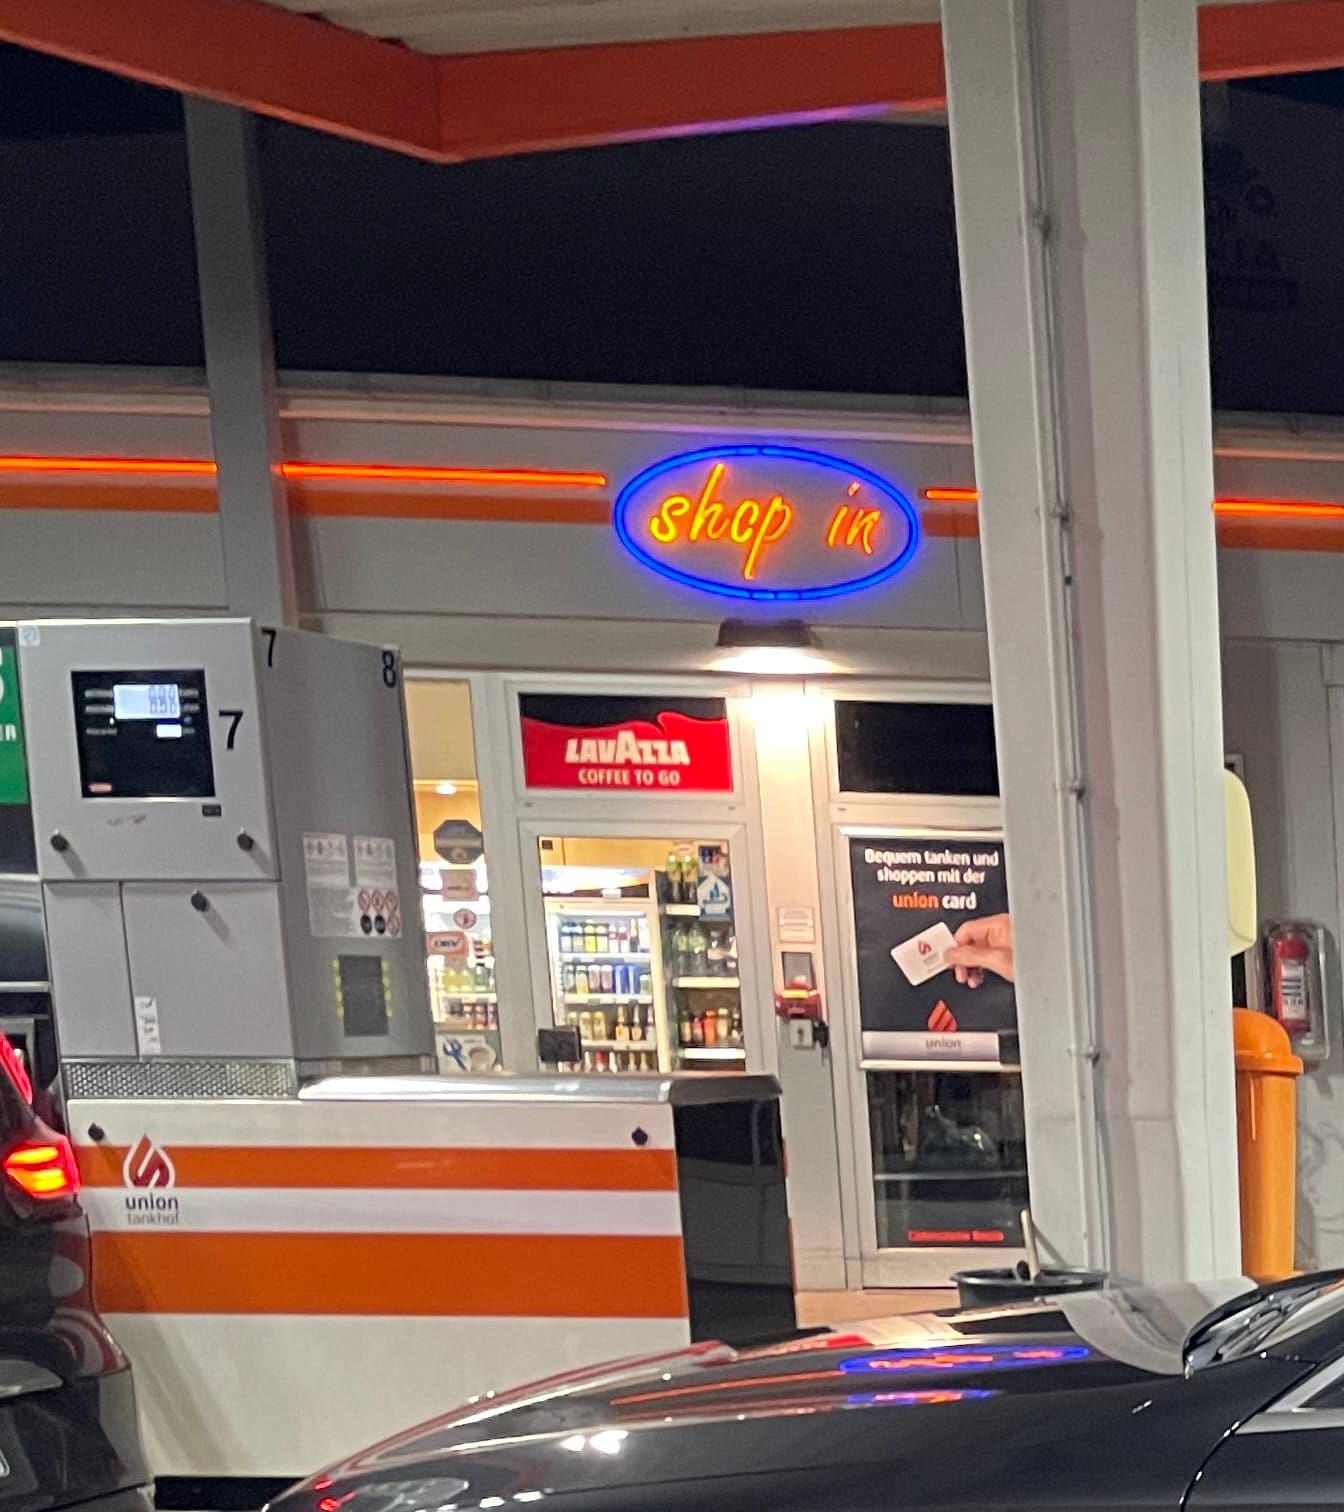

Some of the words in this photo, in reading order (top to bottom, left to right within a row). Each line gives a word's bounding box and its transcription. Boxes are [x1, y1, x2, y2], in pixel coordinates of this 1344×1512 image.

[650, 462, 793, 580] shop
[827, 481, 881, 554] in
[261, 626, 277, 668] 7
[382, 650, 397, 688] 8
[218, 709, 244, 751] 7
[565, 729, 691, 766] LAVAZZA
[578, 767, 630, 785] COFFEE
[634, 768, 653, 785] TO
[658, 769, 681, 786] GO
[864, 848, 922, 867] Bequem
[924, 849, 970, 866] tanken
[973, 851, 999, 867] und
[876, 867, 935, 885] shoppen
[937, 867, 960, 884] mit
[963, 868, 986, 884] der
[892, 891, 940, 909] union
[942, 891, 977, 910] card
[926, 1037, 961, 1050] union
[125, 1191, 179, 1211] union
